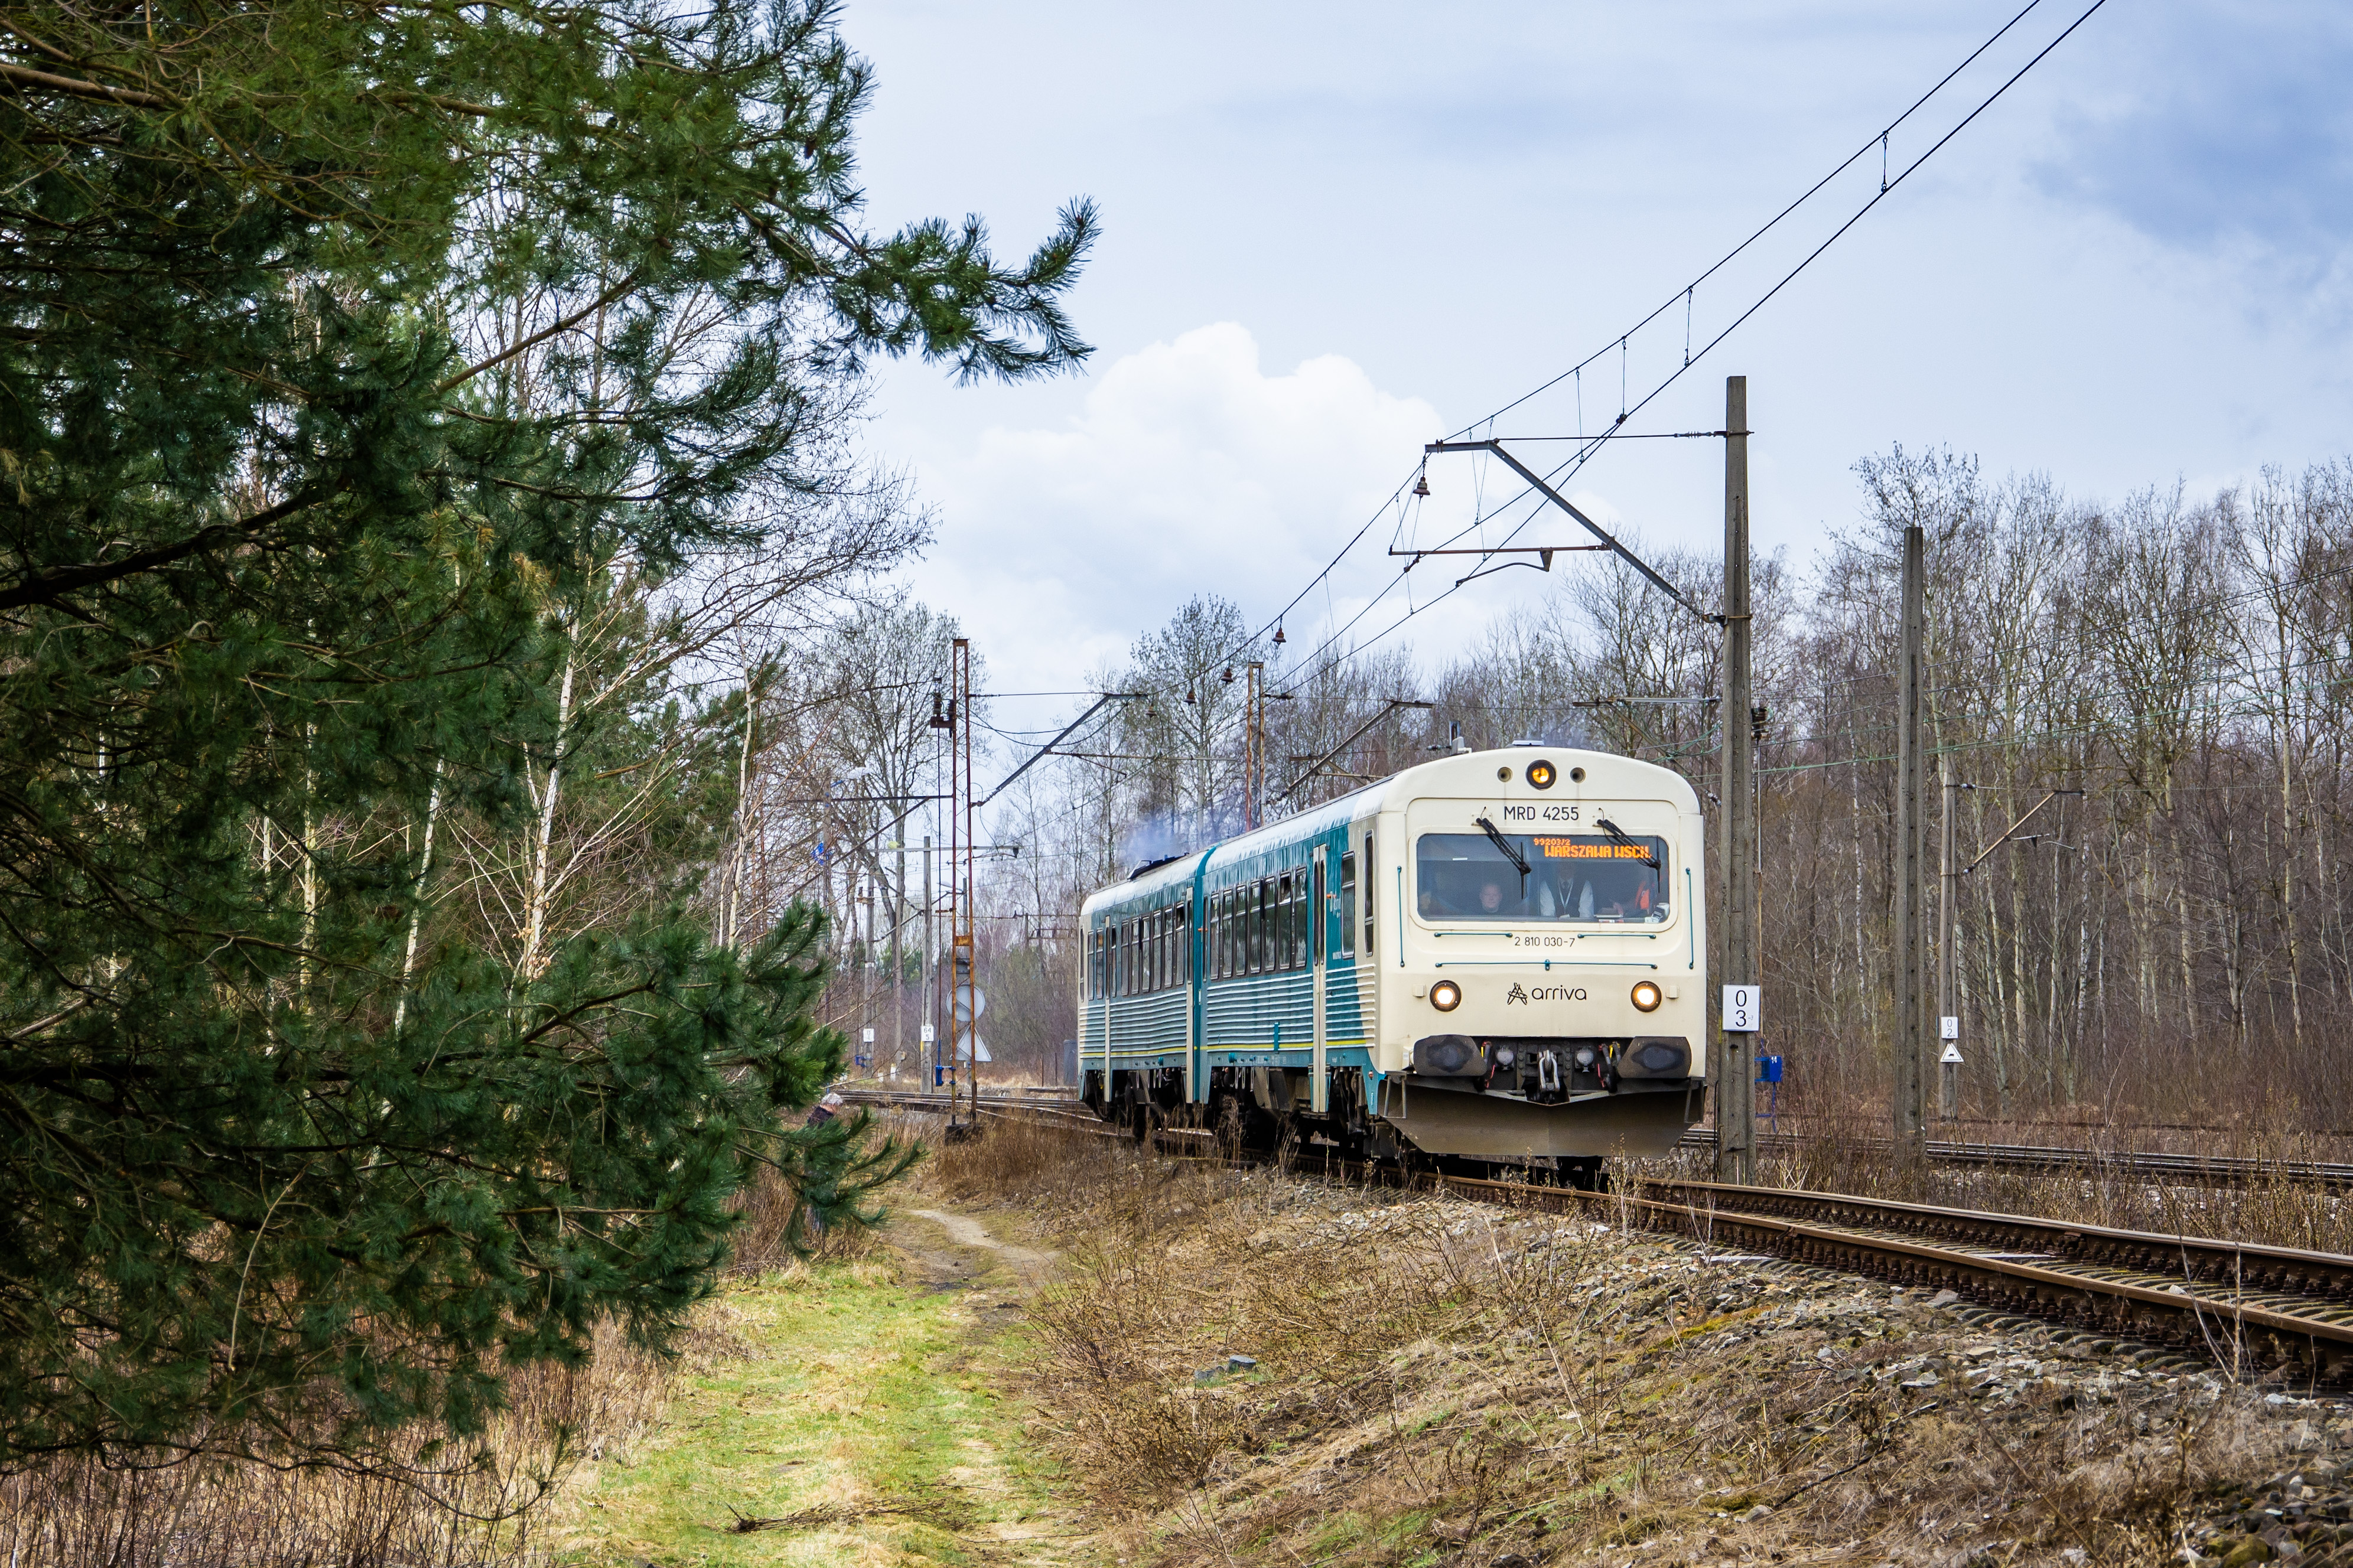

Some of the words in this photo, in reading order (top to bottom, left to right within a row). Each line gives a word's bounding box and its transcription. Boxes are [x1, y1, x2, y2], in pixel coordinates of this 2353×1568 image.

[1504, 806, 1535, 820] MRD
[1542, 807, 1579, 820] 4255
[1544, 845, 1612, 858] WARSZAWA
[1515, 937, 1521, 946] 2
[1525, 937, 1540, 946] 810
[1544, 937, 1575, 947] 030-7
[1531, 985, 1587, 1000] arriva
[1735, 990, 1747, 1007] 0
[1735, 1009, 1747, 1027] 3
[1947, 1019, 1952, 1028] 0
[1947, 1028, 1952, 1037] 2
